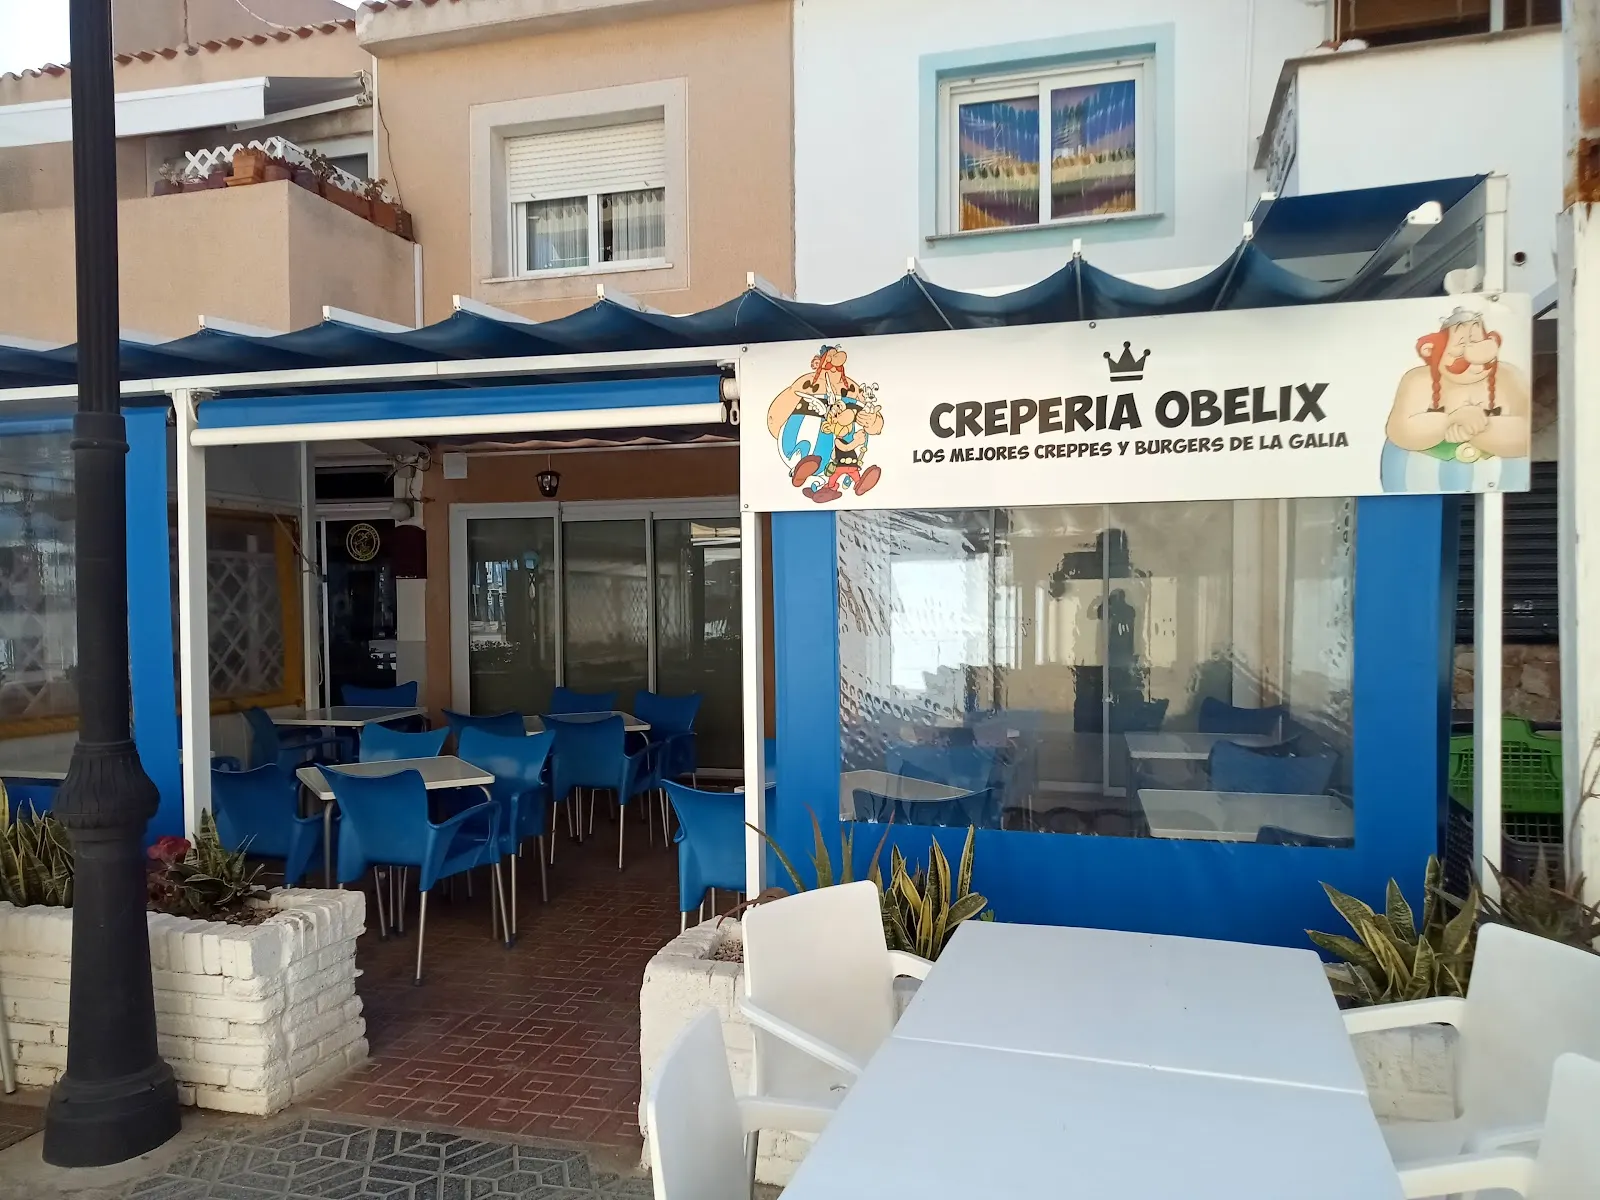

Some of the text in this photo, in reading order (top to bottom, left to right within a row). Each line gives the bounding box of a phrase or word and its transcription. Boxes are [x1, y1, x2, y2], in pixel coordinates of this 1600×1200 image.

[929, 382, 1329, 439] CREPERIA OBELIX
[913, 432, 1349, 463] LOS MEJORES CREPPES Y BURGERS DE LA GALIA
